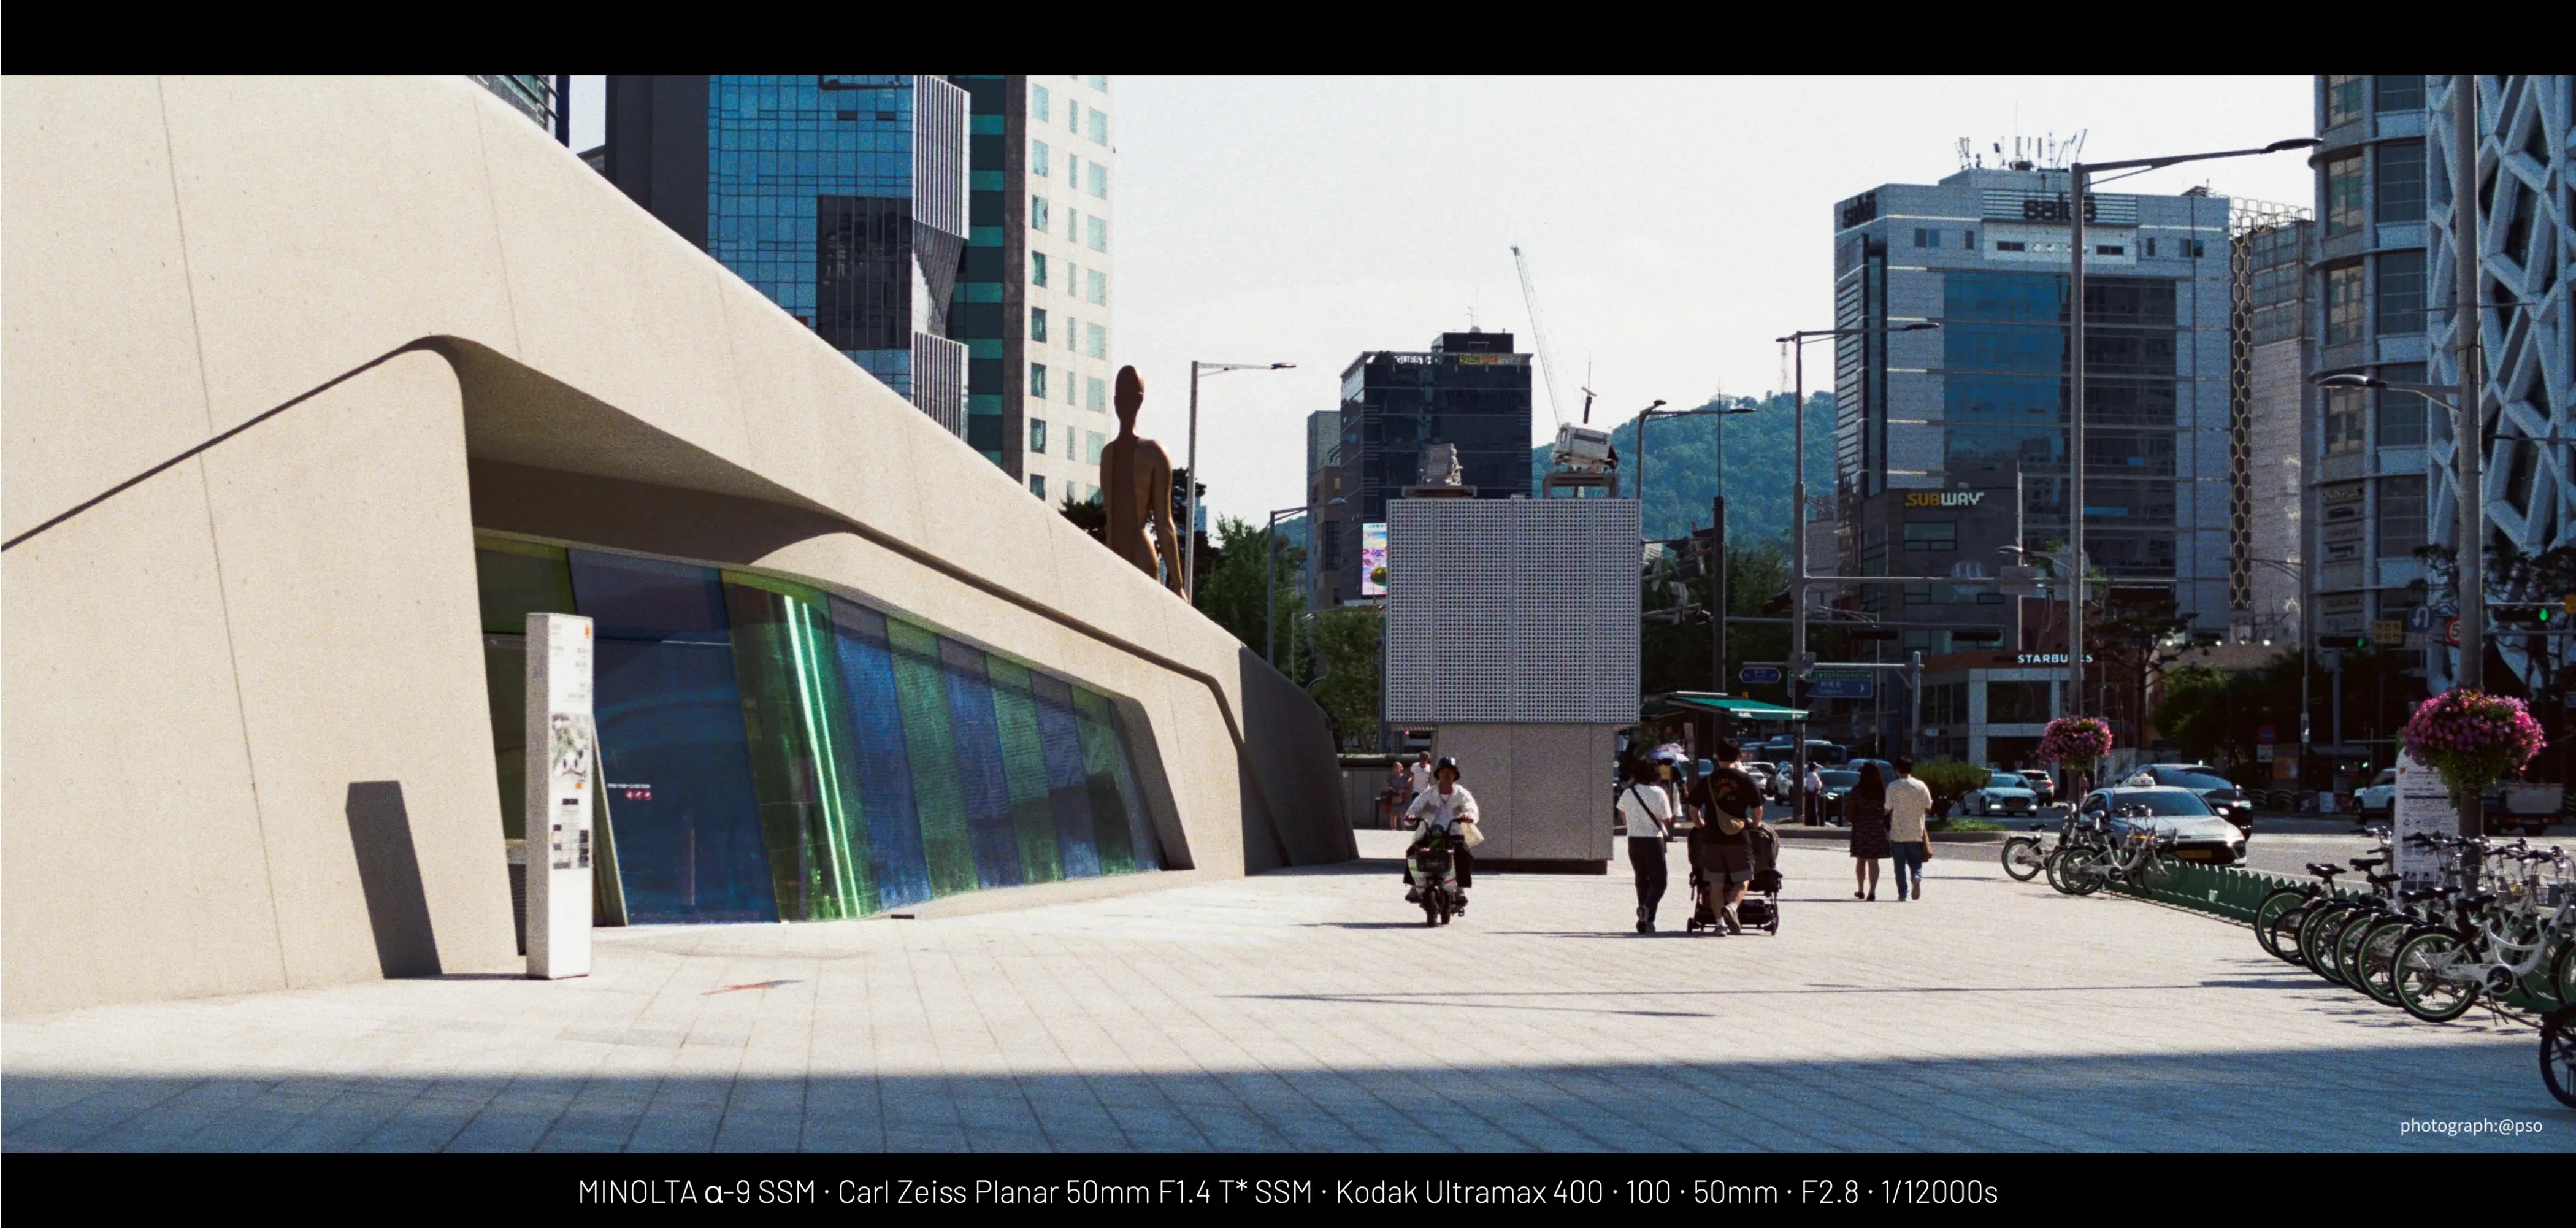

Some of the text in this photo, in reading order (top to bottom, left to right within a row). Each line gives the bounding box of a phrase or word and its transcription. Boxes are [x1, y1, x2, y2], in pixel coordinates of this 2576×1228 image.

[1904, 491, 1985, 507] SUBWAY
[2451, 623, 2460, 638] 5
[2017, 654, 2093, 664] STARBUS
